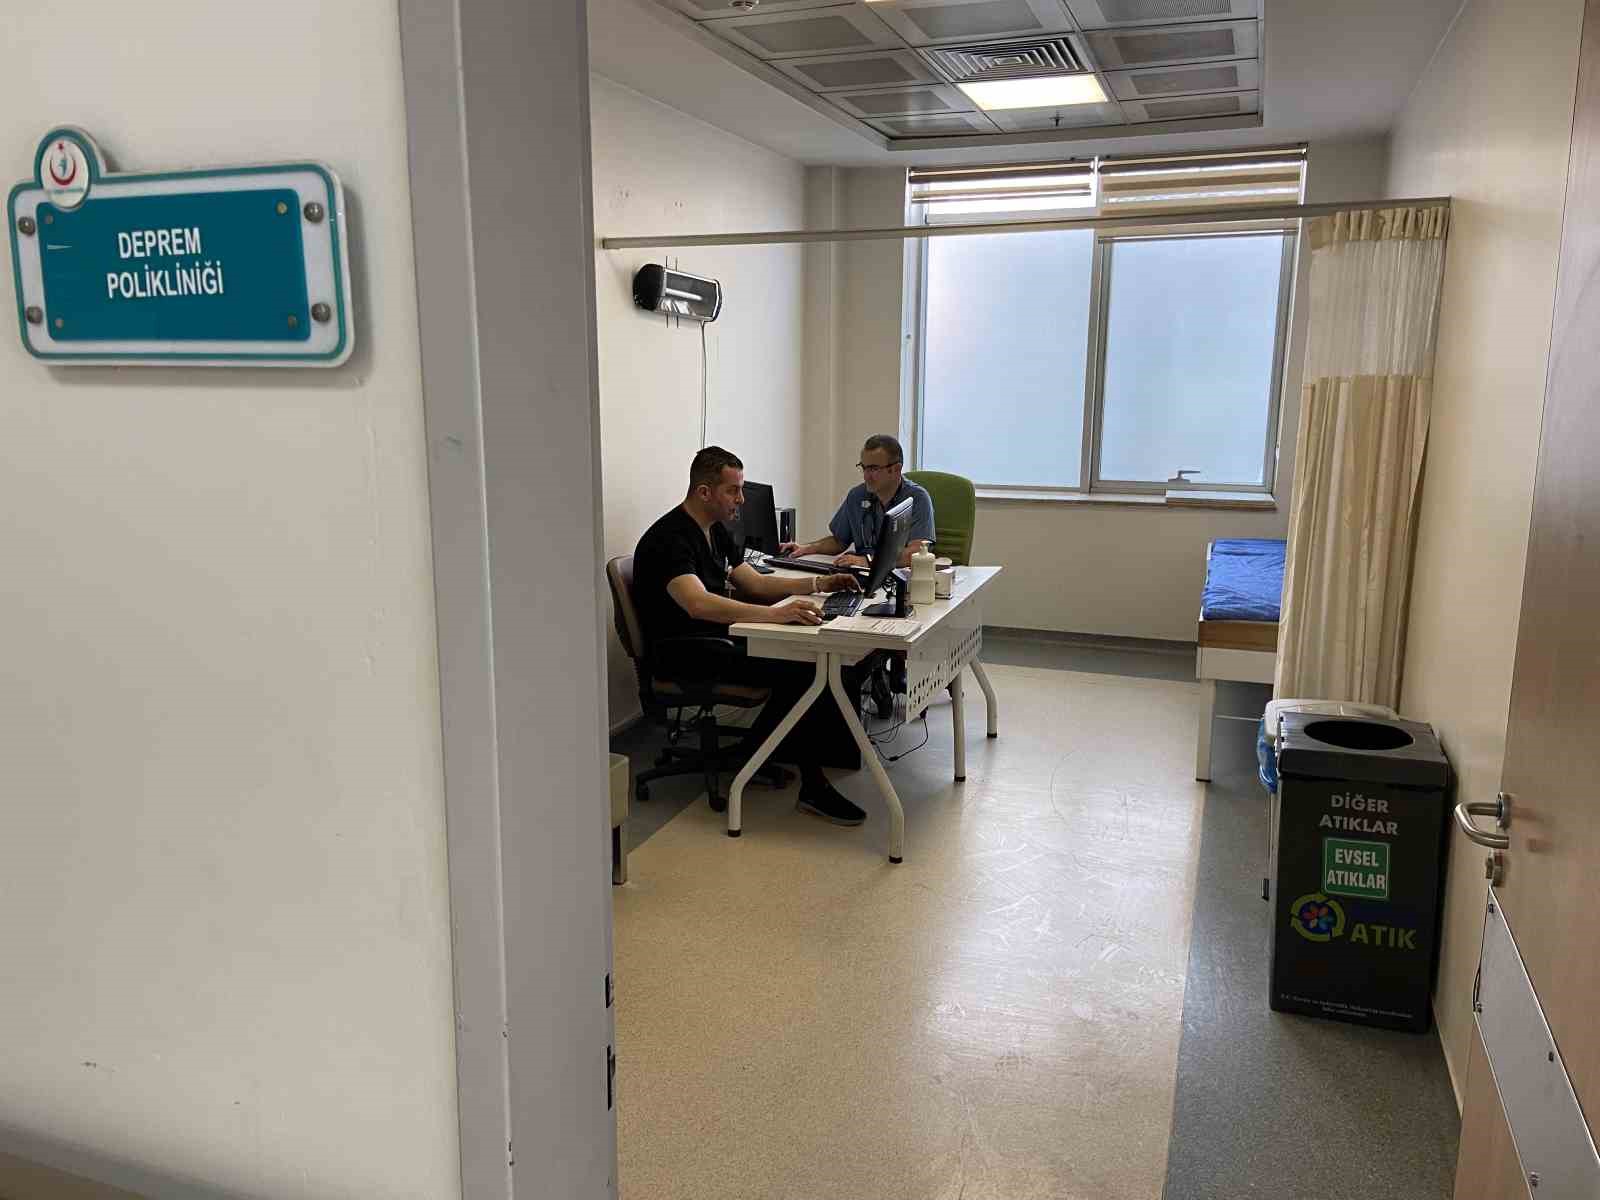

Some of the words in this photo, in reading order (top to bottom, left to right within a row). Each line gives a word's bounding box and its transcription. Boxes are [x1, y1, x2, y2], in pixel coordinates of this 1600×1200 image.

[118, 227, 201, 258] DEPREM
[107, 260, 224, 298] POLİKLİNİĞİ
[1331, 792, 1389, 813] DİĞER
[1319, 814, 1398, 835] ATIKLAR
[1335, 848, 1379, 866] EVSEL
[1326, 870, 1386, 889] ATIKLAR
[1350, 923, 1416, 949] ATIK
